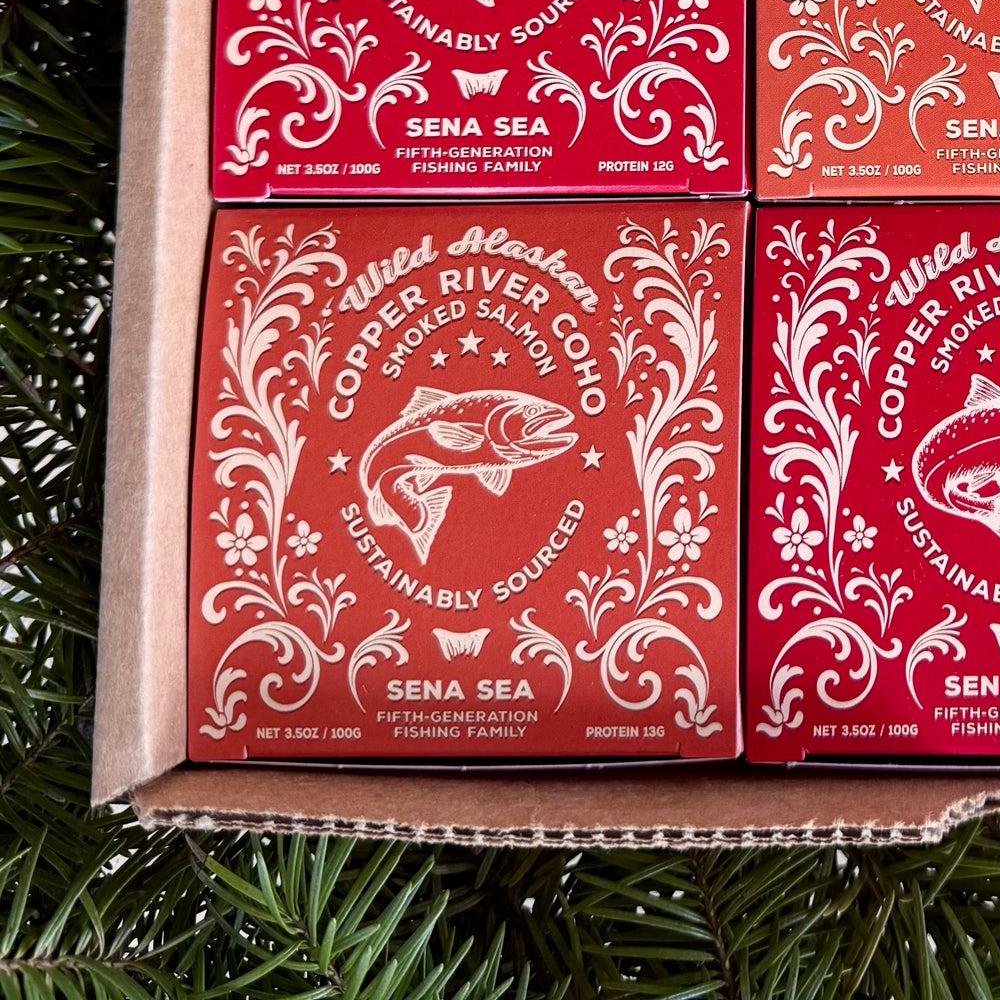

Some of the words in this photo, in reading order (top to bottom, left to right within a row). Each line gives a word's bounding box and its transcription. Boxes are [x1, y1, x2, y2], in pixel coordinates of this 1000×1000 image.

[406, 117, 483, 138] SENA
[494, 116, 550, 137] SEA
[395, 146, 553, 159] FIFTH-GENERATION
[412, 161, 478, 174] FISHING
[483, 160, 542, 173] FAMILY
[598, 160, 649, 172] PROTEIN
[653, 160, 675, 172] 12G
[821, 165, 845, 177] NET
[848, 164, 882, 177] 3.5OZ
[892, 164, 922, 176] 100G
[338, 234, 440, 312] Wild
[446, 225, 599, 313] Alaskan
[884, 231, 978, 307] Wild
[328, 285, 428, 420] COPPER
[439, 266, 550, 313] RIVER
[551, 312, 606, 415] COHO
[381, 299, 466, 379] SMOKED
[475, 298, 557, 376] SALMON
[877, 300, 948, 439] COPPER
[340, 502, 482, 610] SUSTAINABLY
[492, 499, 585, 602] SOURCED
[387, 679, 465, 701] SENA
[476, 679, 535, 701] SEA
[376, 710, 538, 723] FIFTH-GENERATION
[256, 727, 281, 739] NET
[284, 727, 320, 740] 3.5OZ
[331, 727, 362, 739] 100G
[393, 726, 461, 739] FISHING
[467, 726, 527, 738] FAMILY
[585, 726, 640, 738] PROTEIN
[643, 725, 666, 738] 13G
[813, 724, 838, 737] NET
[841, 724, 876, 737] 3.5OZ
[888, 723, 919, 736] 100G
